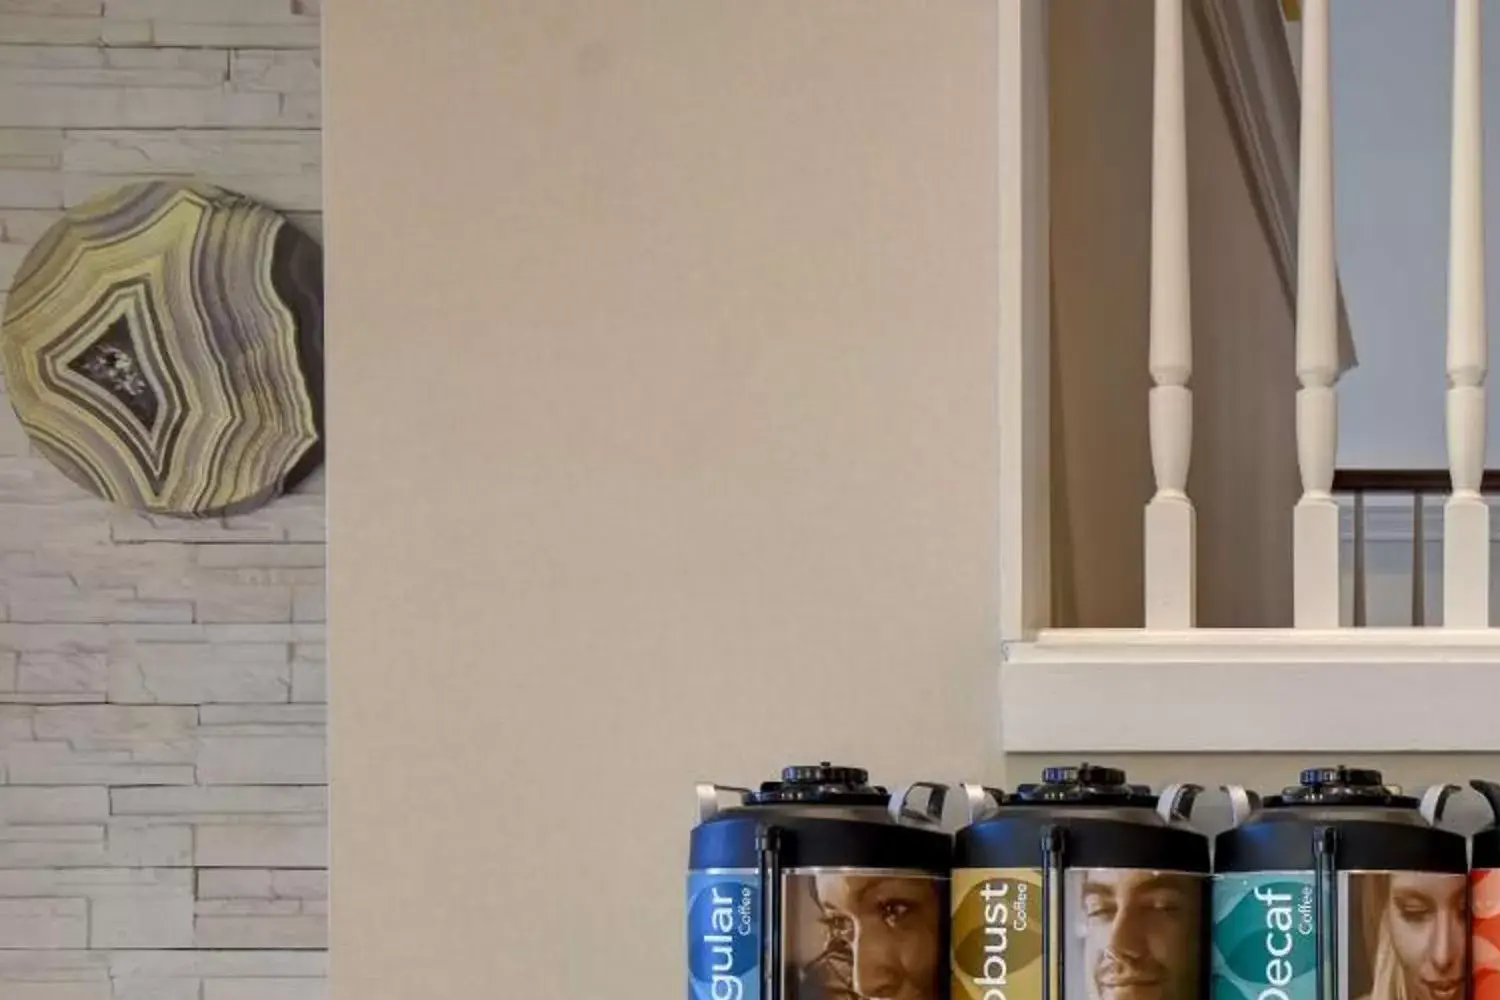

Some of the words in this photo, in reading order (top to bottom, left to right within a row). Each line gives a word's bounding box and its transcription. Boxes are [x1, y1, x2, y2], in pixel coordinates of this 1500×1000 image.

[738, 887, 752, 936] Coffee
[1013, 883, 1028, 931] Coffee
[1299, 886, 1313, 935] Coffee
